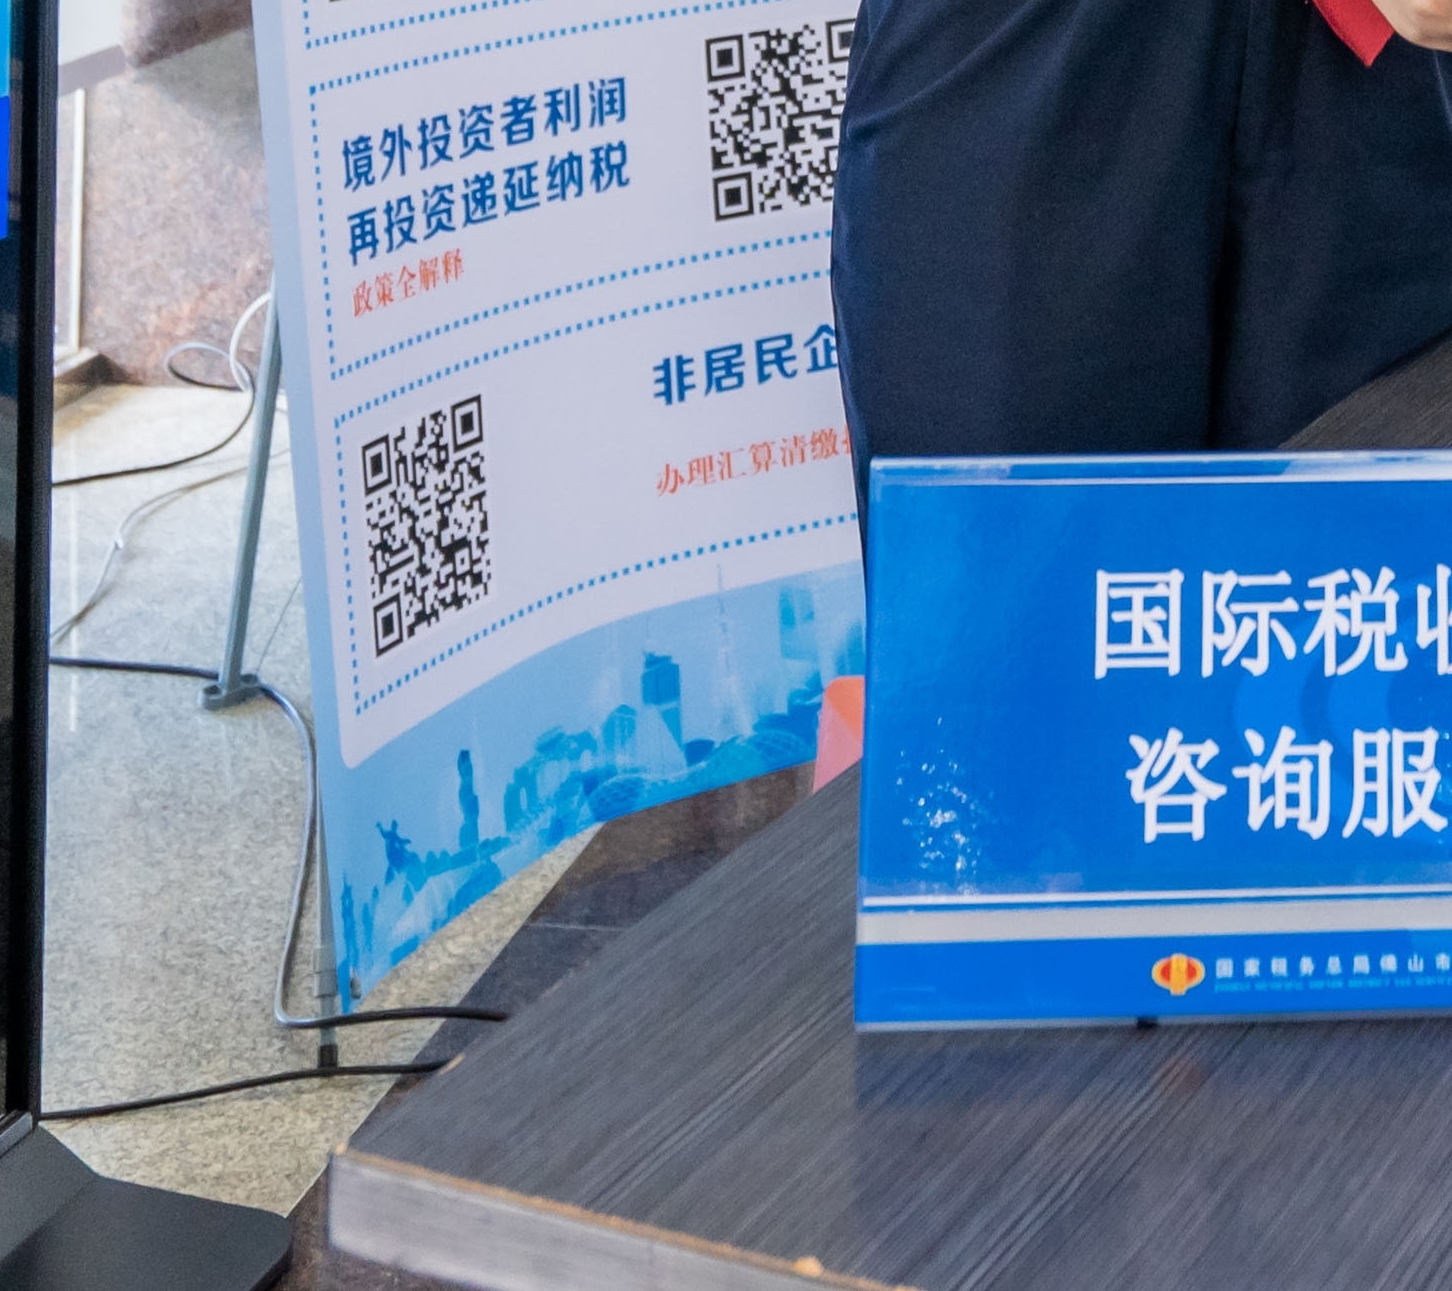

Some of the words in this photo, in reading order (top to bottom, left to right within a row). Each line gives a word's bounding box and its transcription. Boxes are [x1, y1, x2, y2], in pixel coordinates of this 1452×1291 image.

[341, 75, 628, 191] 境外投资者利润
[347, 140, 630, 266] 再投资递延纳税
[351, 248, 465, 317] 政策全解释
